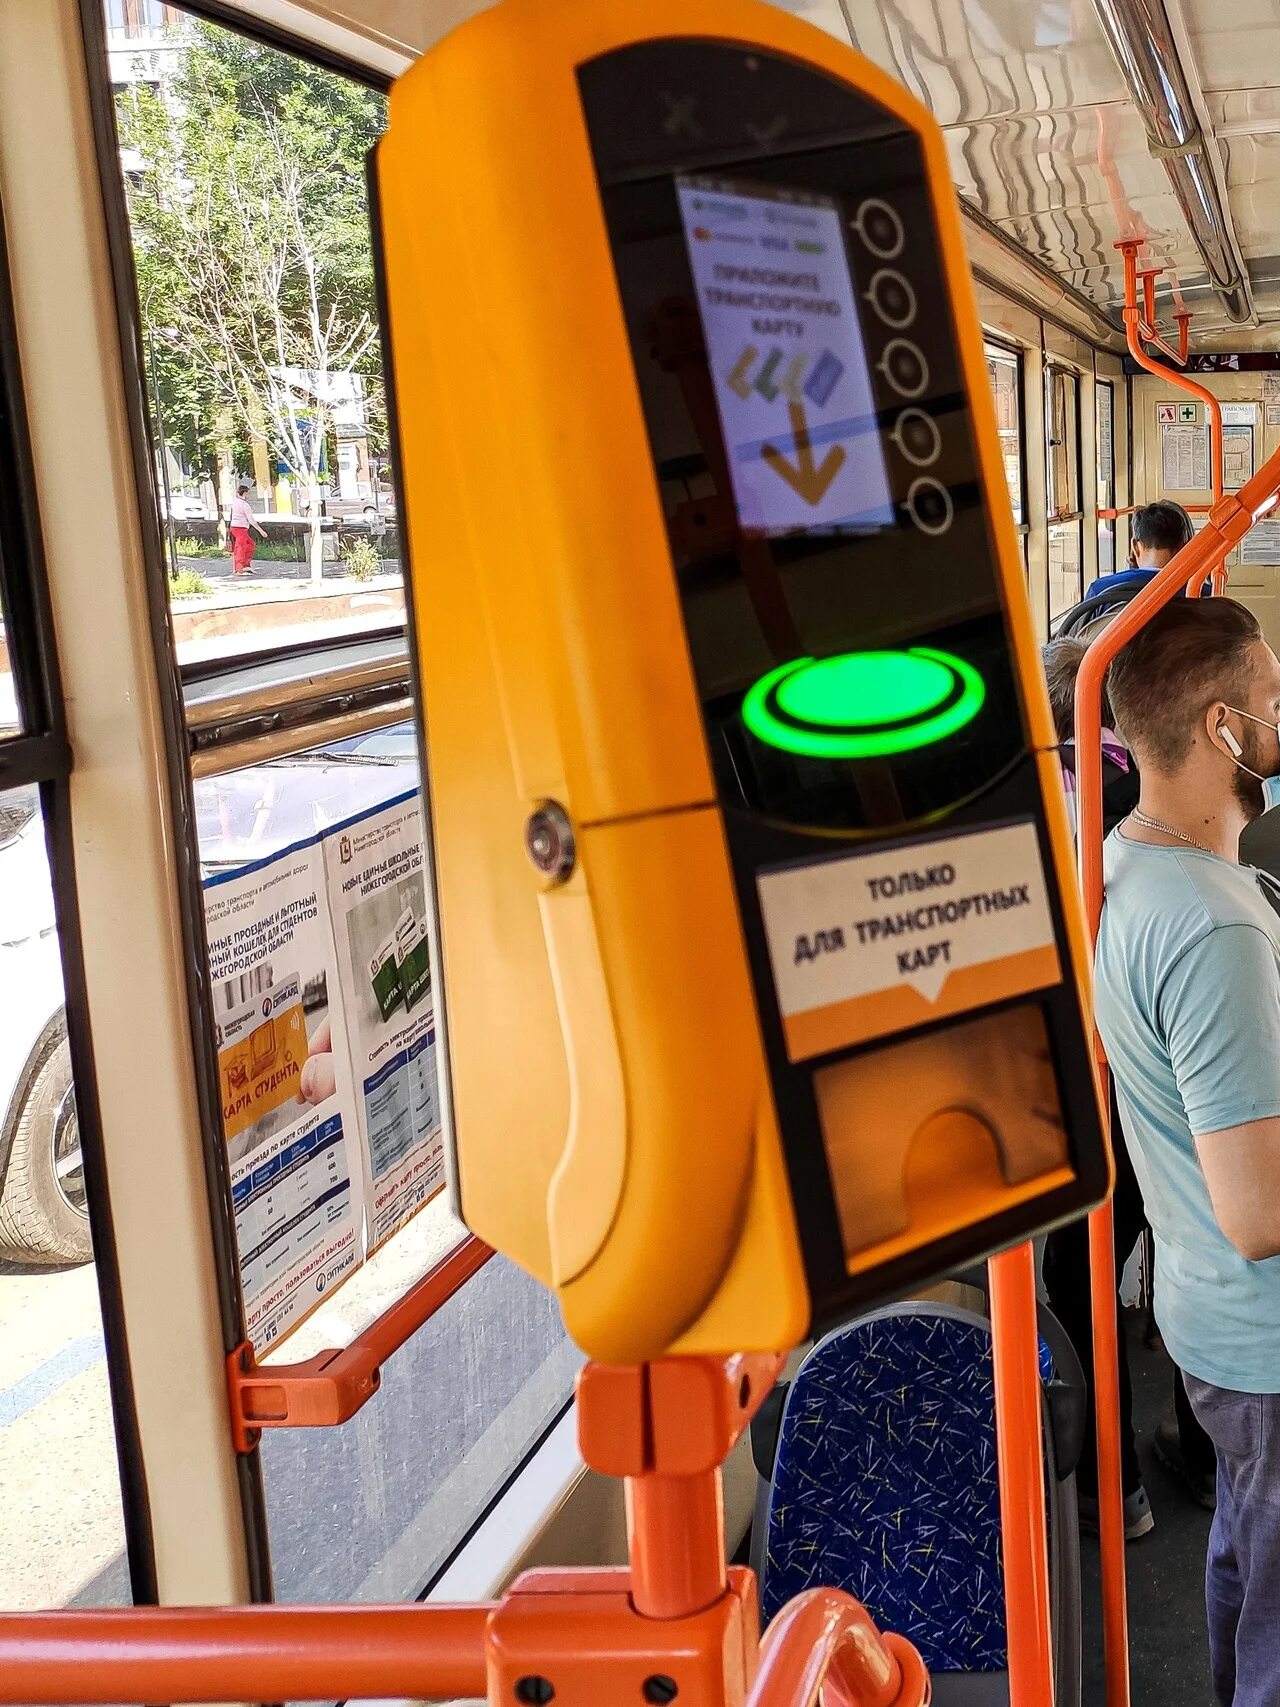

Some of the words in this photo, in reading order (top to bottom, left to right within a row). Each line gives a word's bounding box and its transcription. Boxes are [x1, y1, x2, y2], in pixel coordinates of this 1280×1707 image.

[342, 873, 362, 894] НОВЫЕ
[360, 859, 411, 897] НИЖЕГОРОДСКОЙ
[865, 862, 957, 901] ТОЛЬКО
[233, 933, 267, 958] КОШЕЛЕК
[280, 906, 318, 932] СТУДЕНТОВ
[234, 914, 275, 944] ПРОЕЗДНЫЕ
[280, 891, 318, 920] ЛЬГОТНЫЙ
[793, 928, 847, 966] ДЛЯ
[853, 883, 1031, 945] ТРАНСПОРТНЫХ
[268, 929, 294, 954] ОБЛАСТИ
[896, 940, 954, 975] КАРТ
[254, 1060, 300, 1099] СТУДЕНТА
